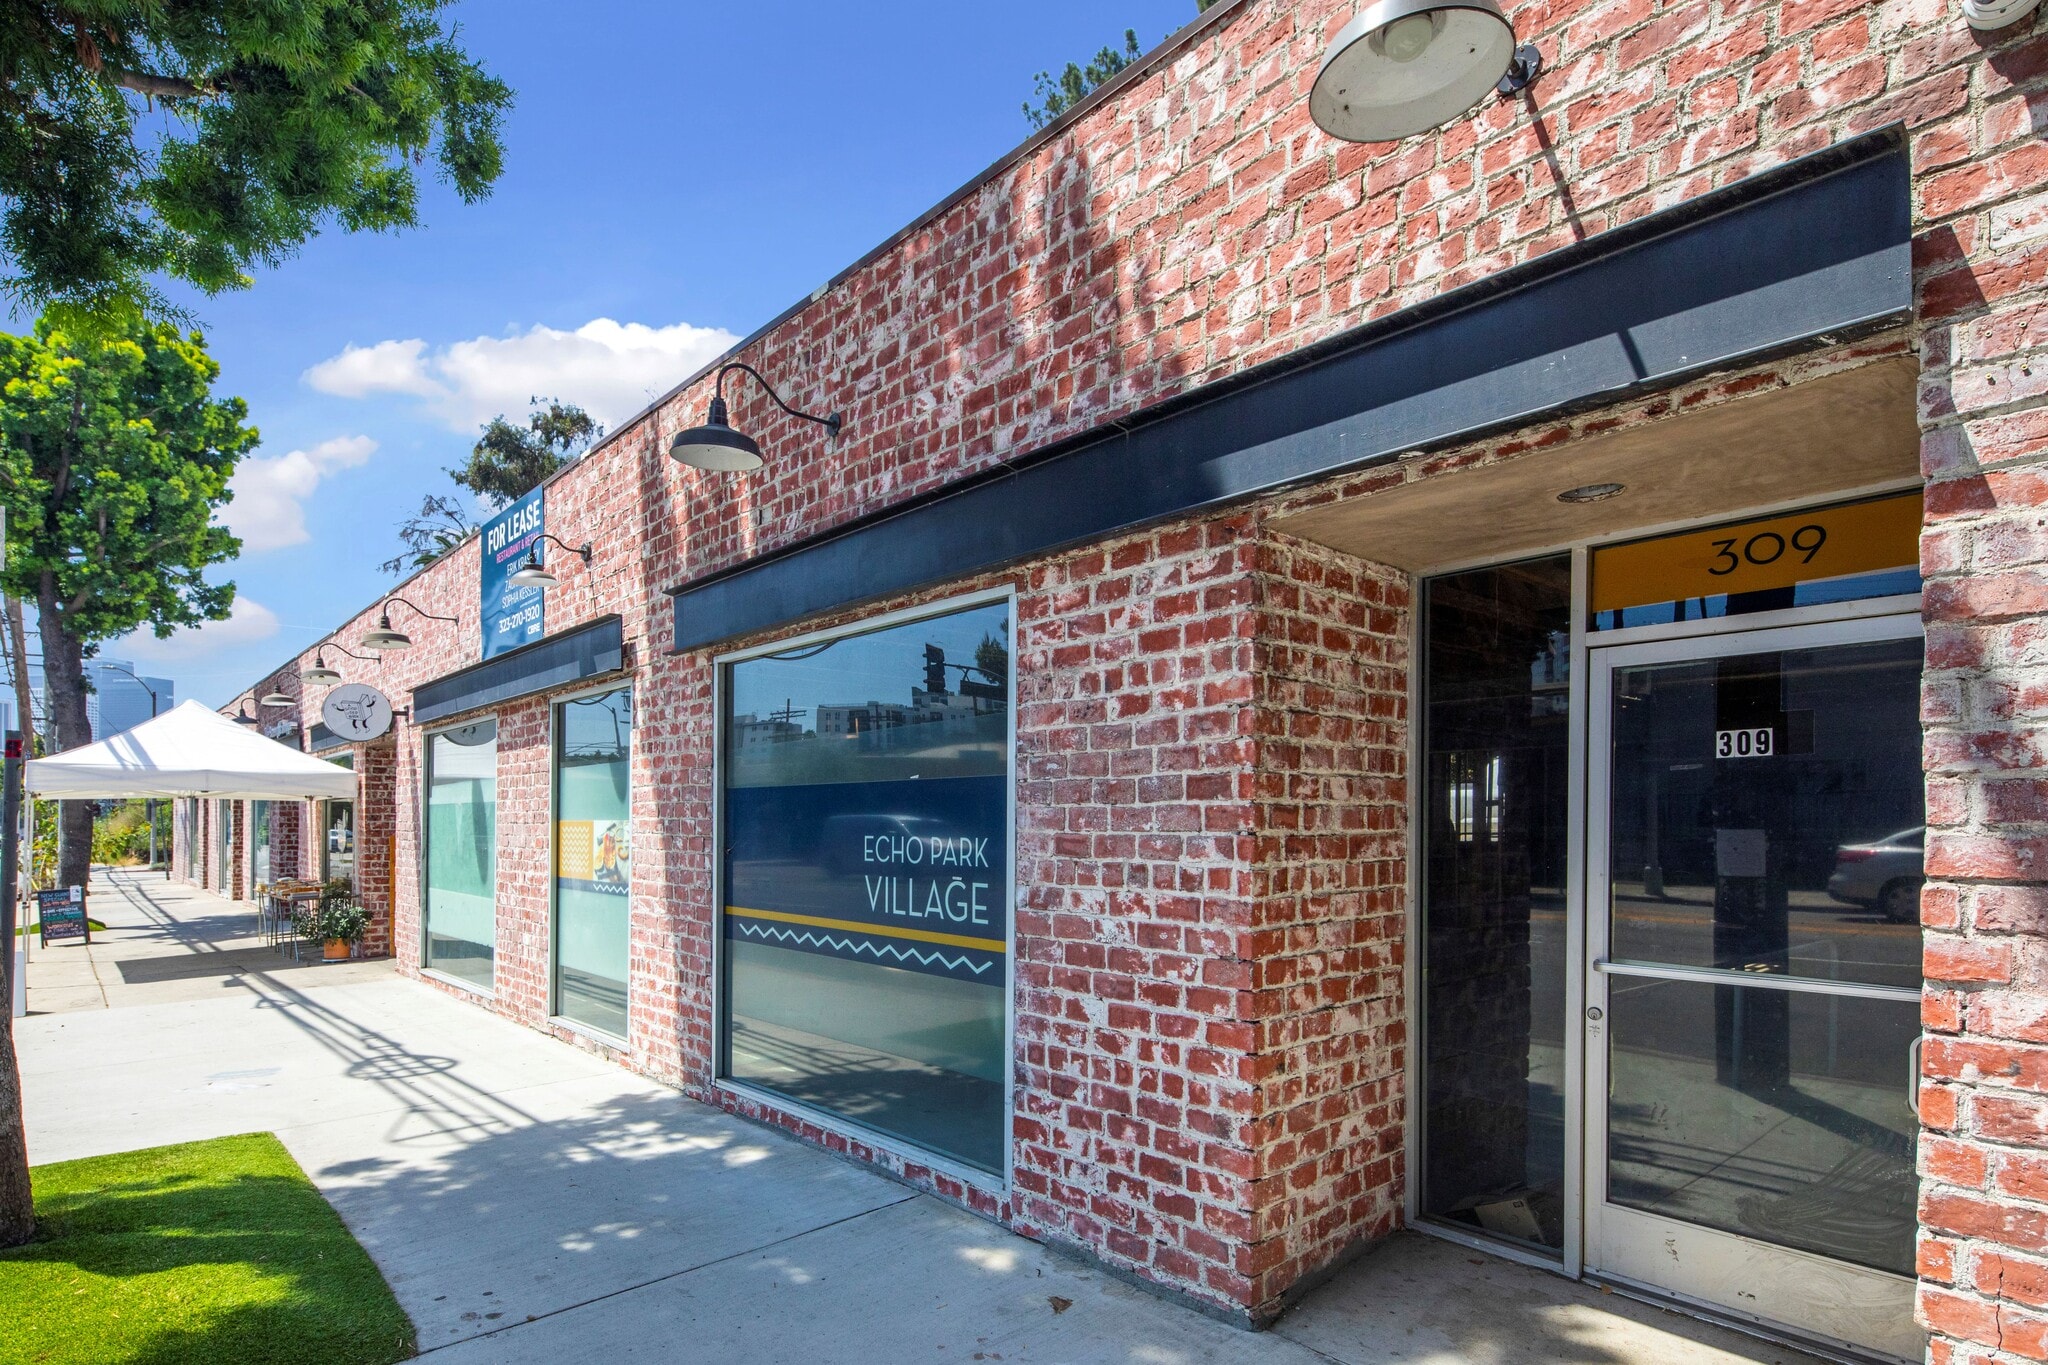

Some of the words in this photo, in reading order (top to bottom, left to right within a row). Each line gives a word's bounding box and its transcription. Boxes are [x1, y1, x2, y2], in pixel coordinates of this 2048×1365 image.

[488, 522, 506, 555] FOR
[508, 499, 540, 543] LEASE
[496, 540, 521, 564] RESTAURANT
[1708, 525, 1827, 575] 309
[502, 590, 519, 609] SOPHIA
[498, 603, 540, 634] 323-270-1920
[527, 622, 541, 635] CBRE
[1719, 729, 1770, 757] 309
[864, 835, 924, 865] ECHO
[930, 836, 989, 868] PARK
[864, 875, 989, 925] VILLAGE
